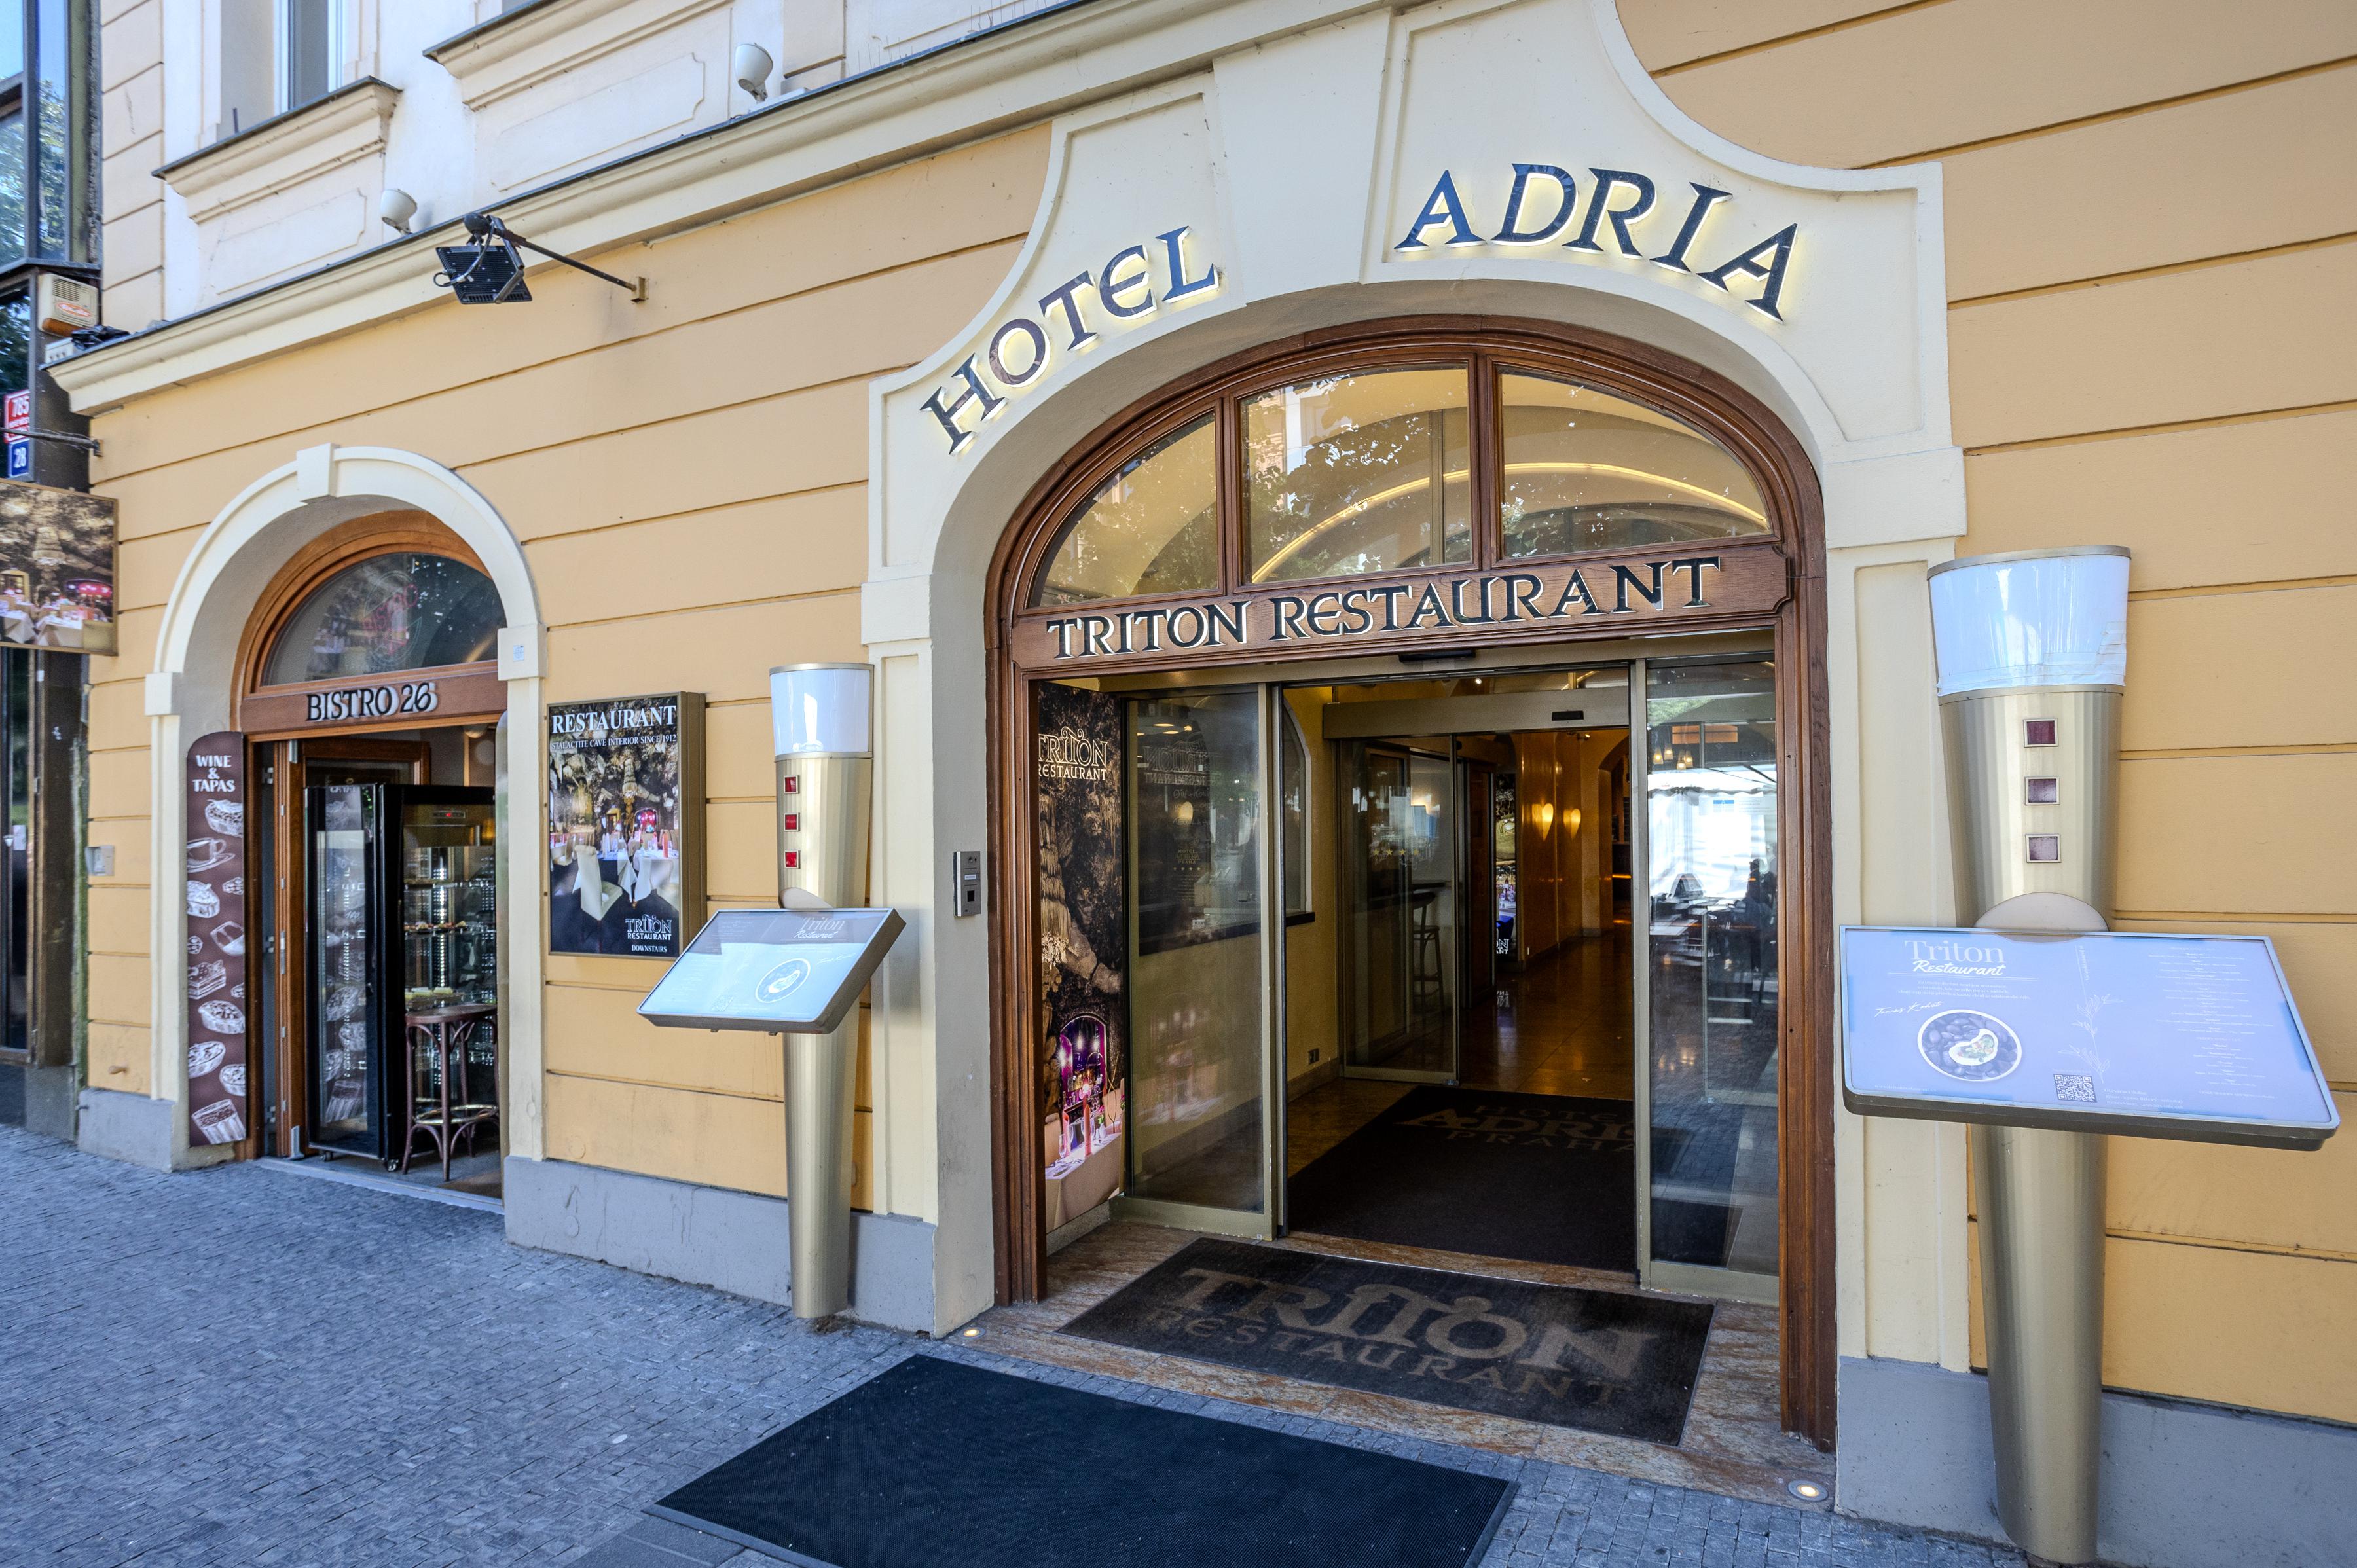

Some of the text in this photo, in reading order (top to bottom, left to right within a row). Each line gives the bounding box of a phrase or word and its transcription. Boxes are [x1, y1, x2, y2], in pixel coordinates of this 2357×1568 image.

[919, 162, 1798, 456] HOTEL ADRIA
[14, 447, 27, 468] 28
[1048, 556, 1721, 659] TRITON RESTAURANT
[306, 682, 438, 721] BISTRO 26
[551, 705, 676, 733] RESTAURANT
[551, 740, 589, 750] STALACTITE
[590, 738, 607, 748] CAVE
[608, 737, 639, 746] INTERIOR
[640, 735, 660, 744] SINCE
[196, 755, 232, 768] WINE
[208, 767, 220, 780] &
[192, 779, 236, 792] TAPAS
[625, 914, 672, 934] TRITON
[800, 917, 846, 930] Triton
[1905, 940, 2006, 963] Triton
[1912, 960, 2006, 976] Restaurant
[1182, 1267, 1658, 1379] TRITON
